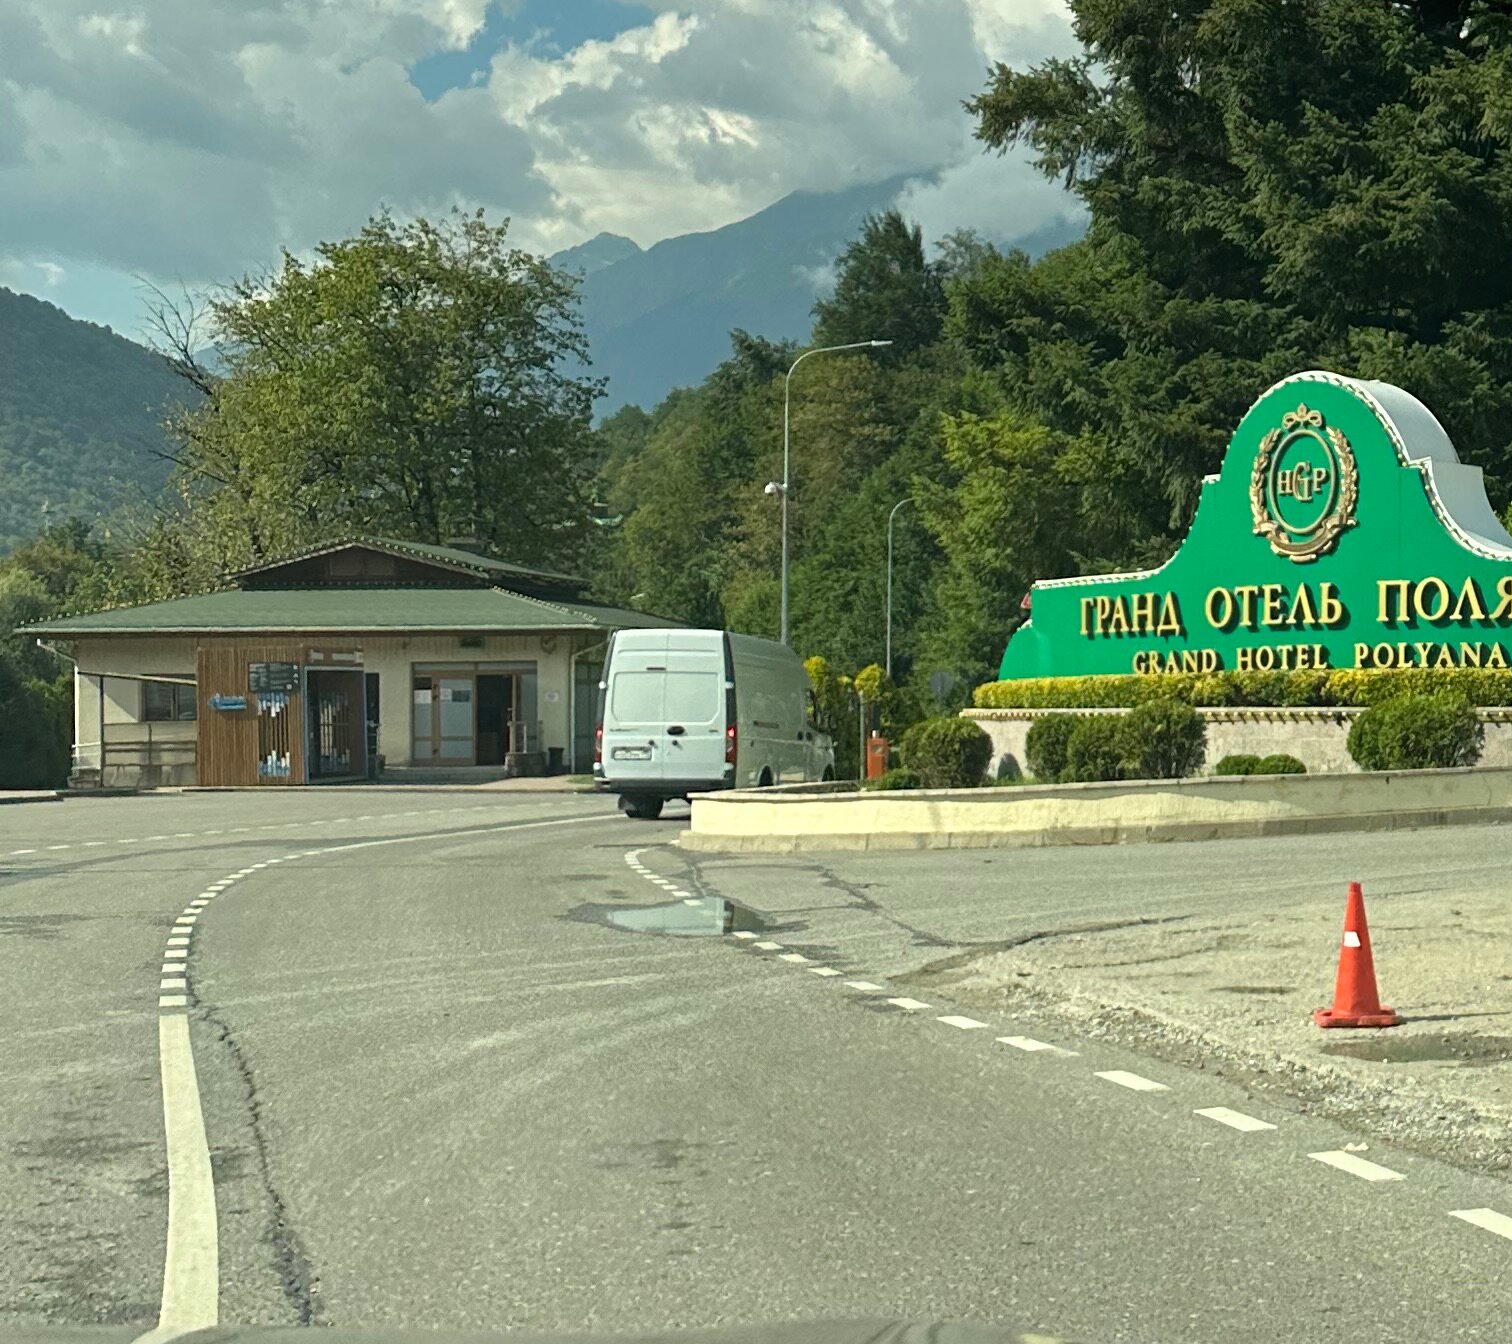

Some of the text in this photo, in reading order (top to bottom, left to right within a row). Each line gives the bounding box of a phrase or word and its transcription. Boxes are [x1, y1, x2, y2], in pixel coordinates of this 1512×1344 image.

[1080, 590, 1180, 637] ГРАНД
[1204, 582, 1343, 629] ОТЕЛЬ
[1132, 641, 1508, 675] GRAND HOTEL POLYANA
